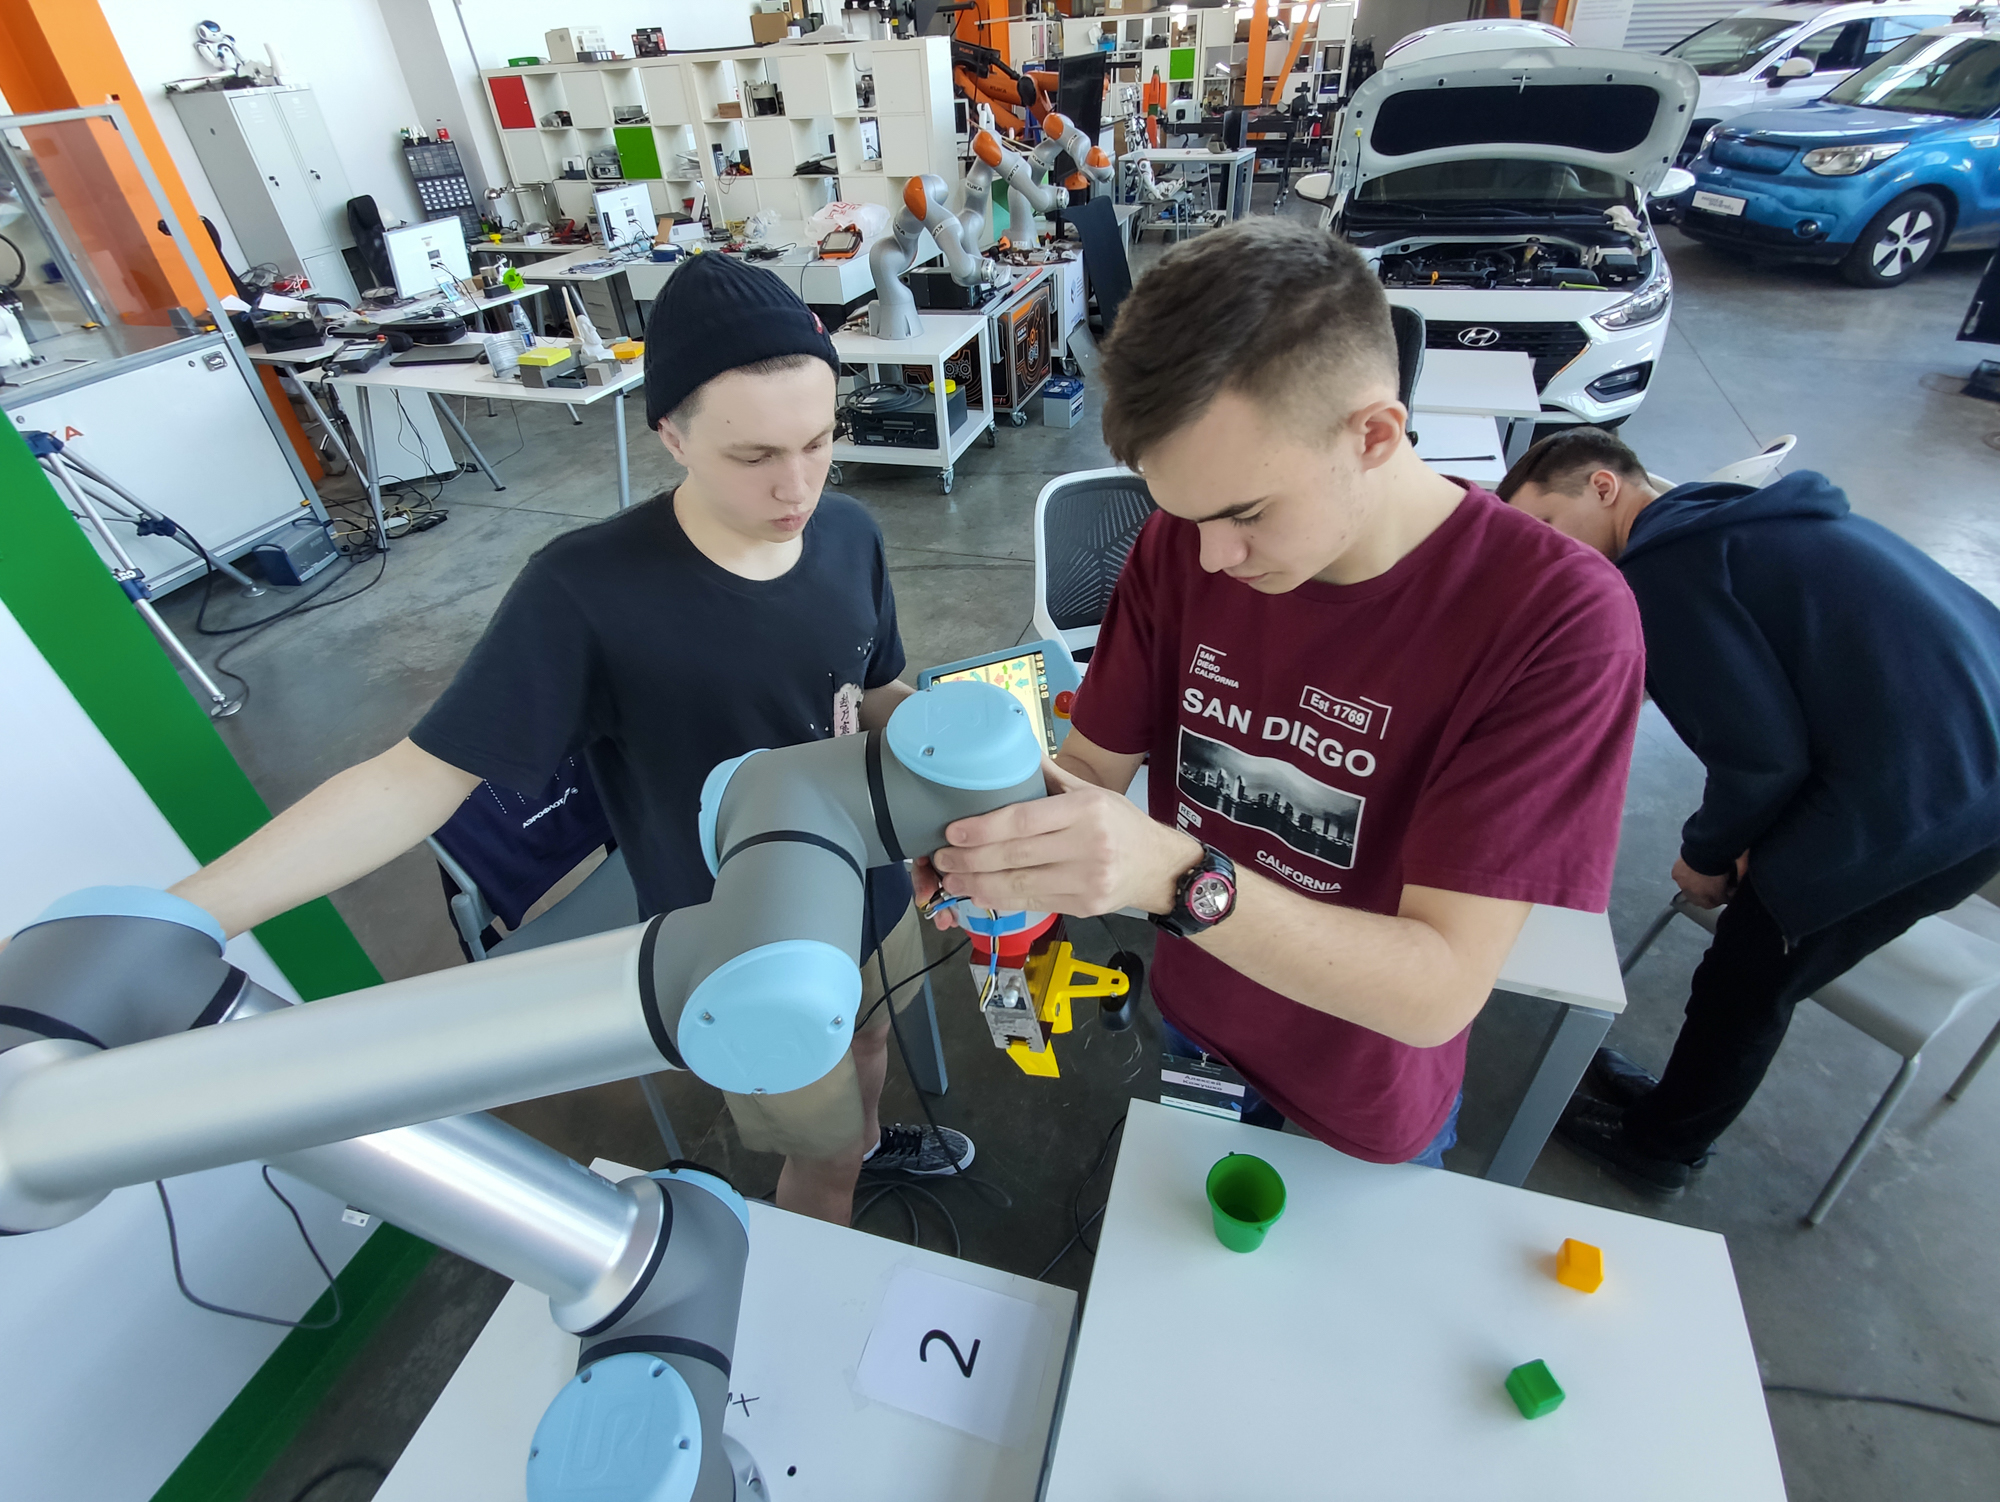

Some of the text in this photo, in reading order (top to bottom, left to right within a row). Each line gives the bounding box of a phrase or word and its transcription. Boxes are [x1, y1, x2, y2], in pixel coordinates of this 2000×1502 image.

[990, 86, 1007, 94] KUKA
[1008, 164, 1019, 182] KUKA
[967, 182, 983, 192] KUKA
[1196, 658, 1221, 673] DIEGO
[1198, 650, 1216, 662] SAN
[1194, 667, 1239, 689] CALIFORNIA
[1309, 694, 1366, 727] Est 1769
[1182, 687, 1377, 778] SAN DIEGO
[1256, 849, 1342, 891] CALIFORNIA
[919, 1329, 981, 1379] 2
